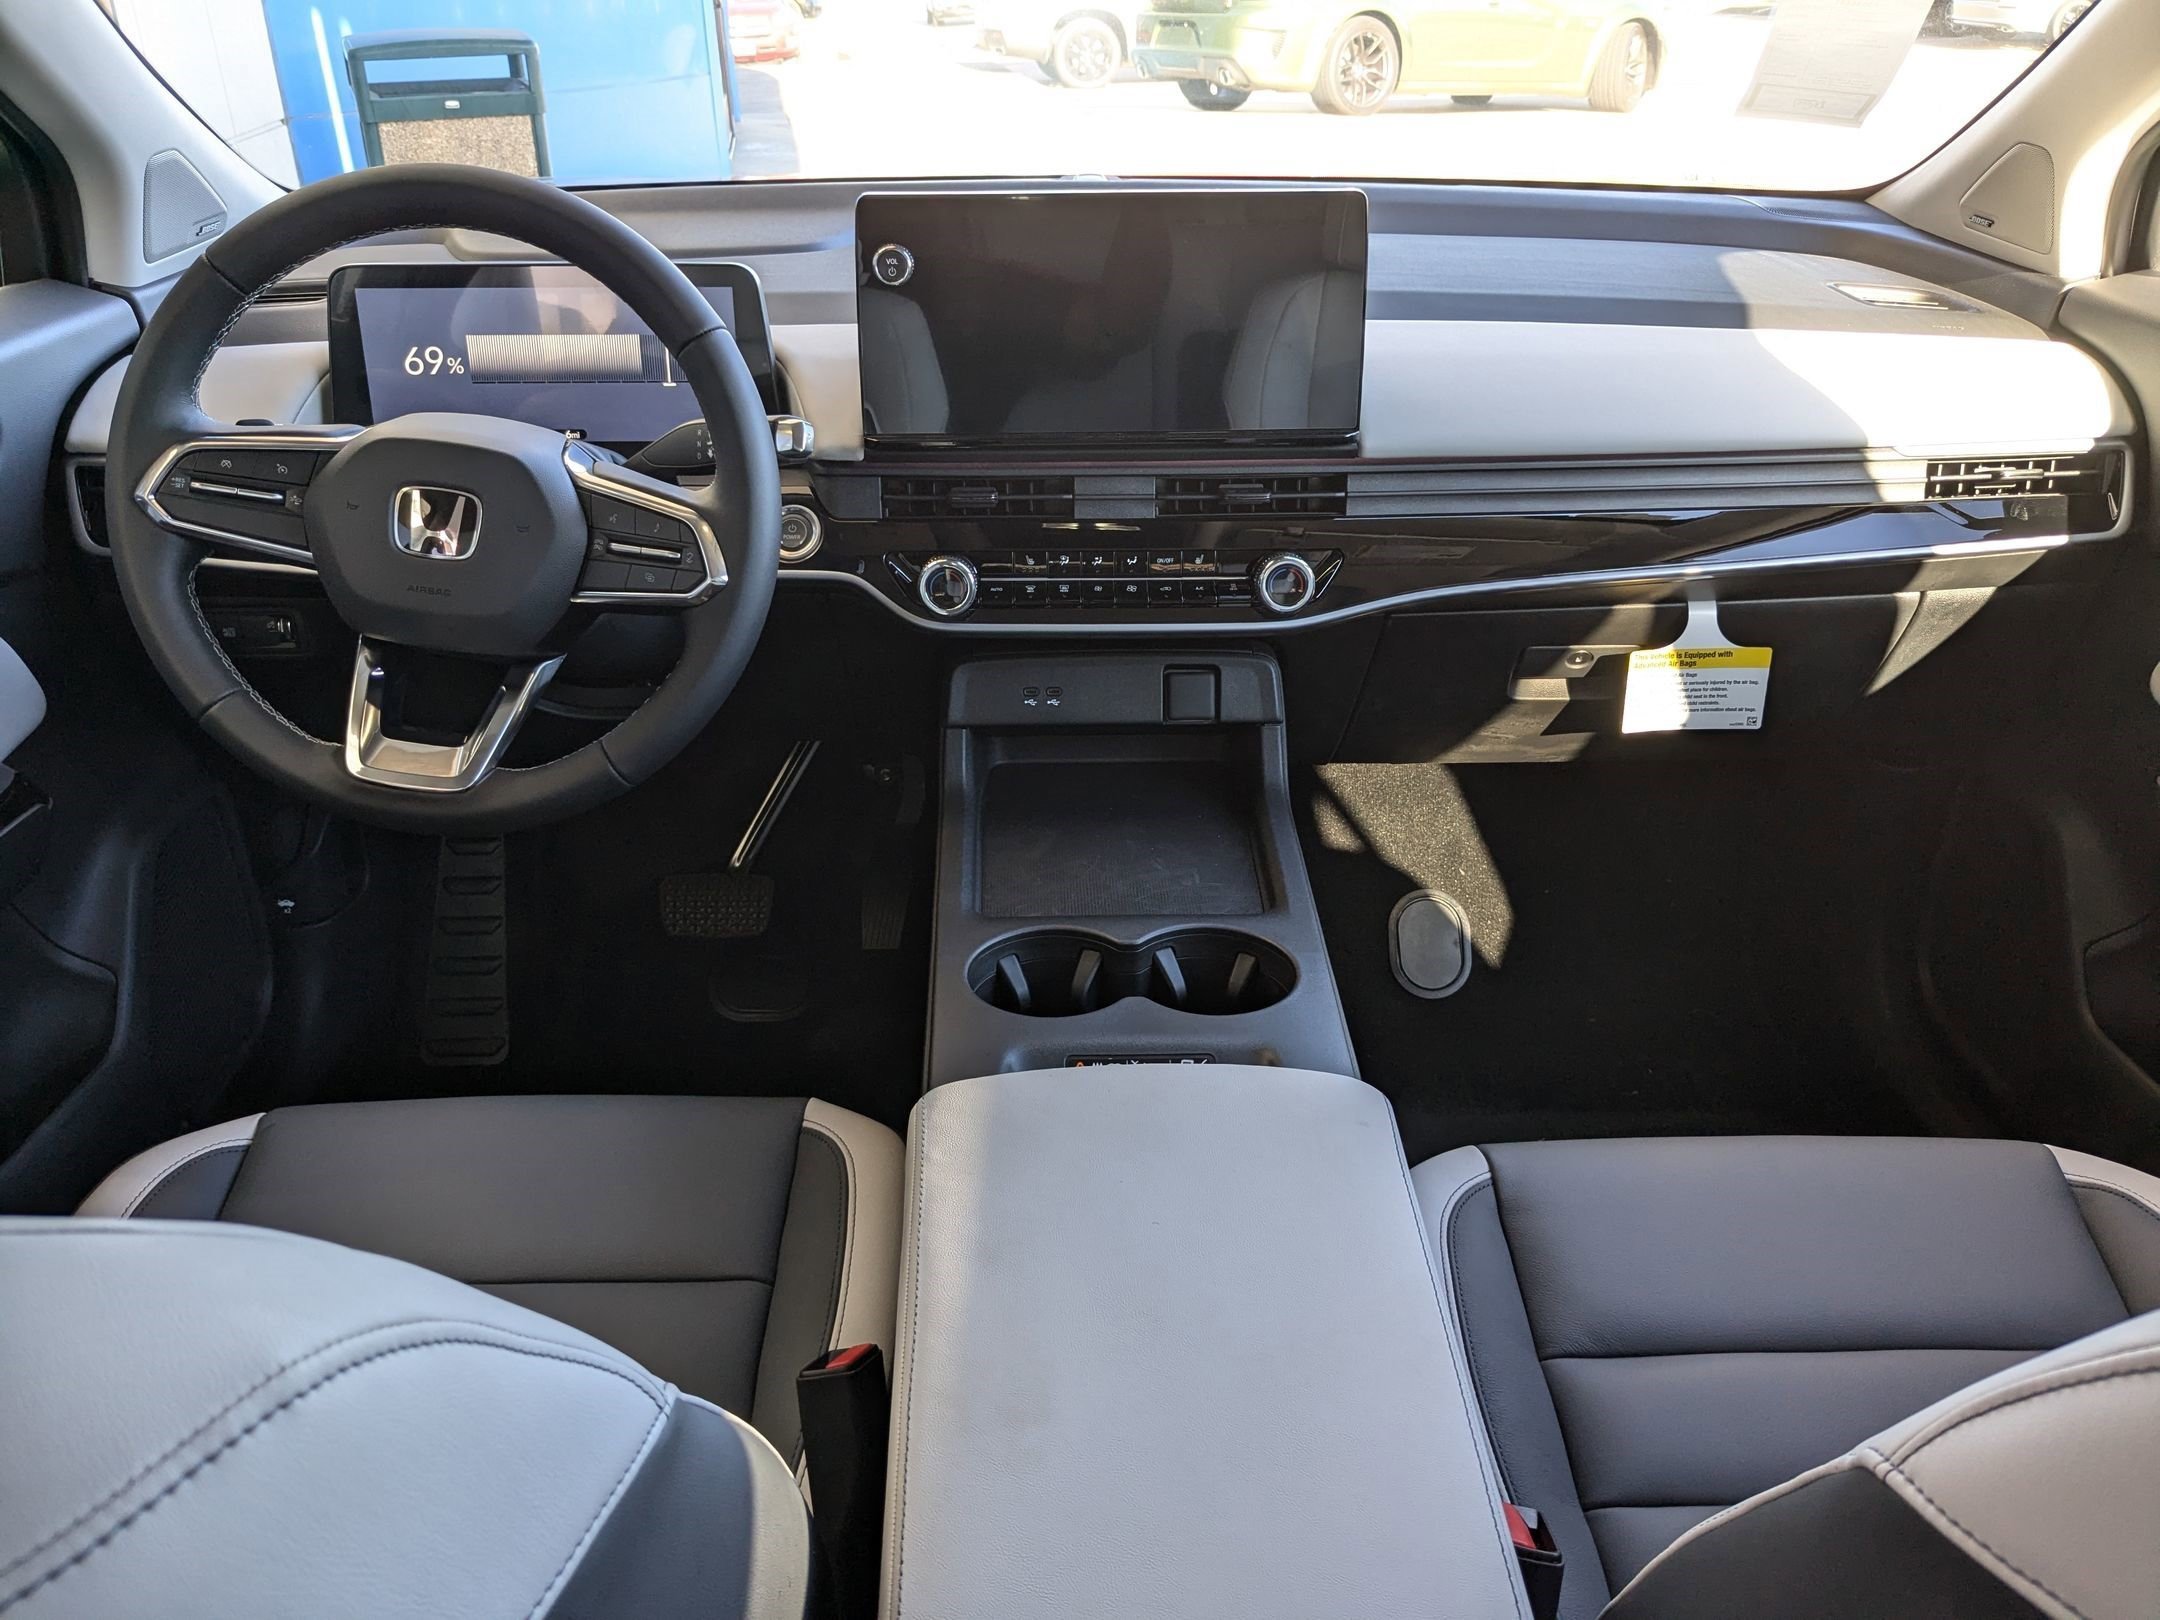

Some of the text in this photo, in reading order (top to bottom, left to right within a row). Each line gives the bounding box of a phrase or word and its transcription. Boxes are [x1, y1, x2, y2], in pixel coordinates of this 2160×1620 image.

[1969, 215, 1994, 227] BOSE
[697, 440, 702, 448] N
[406, 584, 452, 597] AIRBAG
[1684, 651, 1716, 660] Equipped
[1679, 660, 1697, 668] Bags
